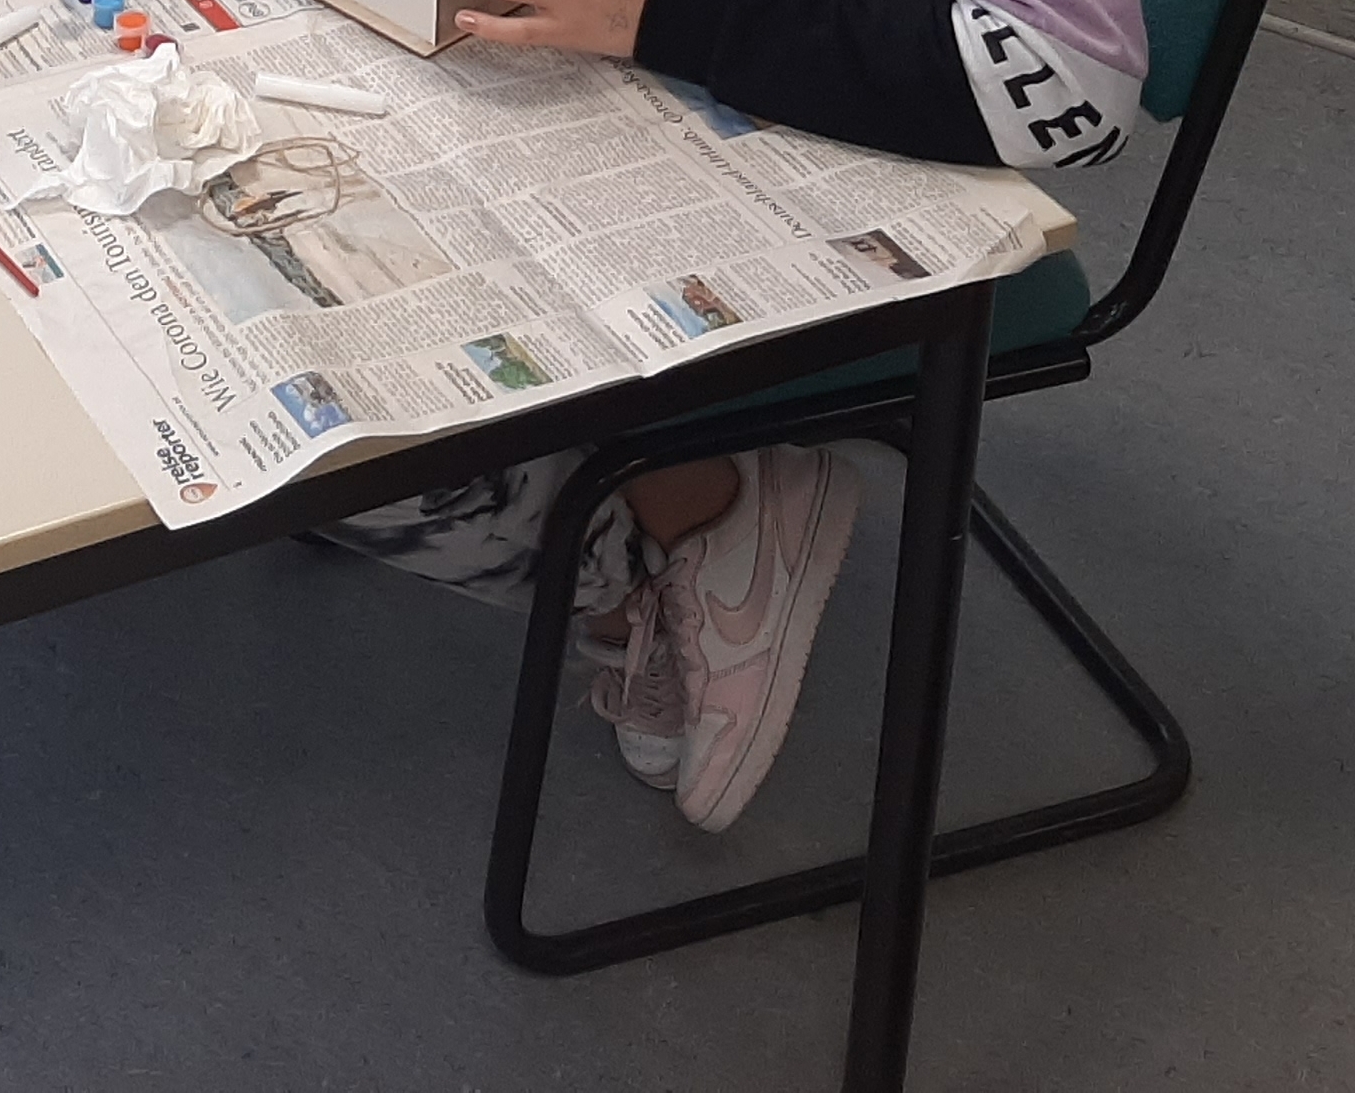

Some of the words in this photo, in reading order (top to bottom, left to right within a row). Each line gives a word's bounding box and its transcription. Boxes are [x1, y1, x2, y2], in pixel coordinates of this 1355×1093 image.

[972, 8, 1130, 168] LLEN
[7, 128, 62, 172] ändert
[73, 205, 131, 272] Touris
[126, 268, 157, 303] den
[150, 303, 207, 371] Corona
[201, 368, 237, 413] Wie
[153, 419, 205, 480] reporter
[156, 447, 190, 485] reise
